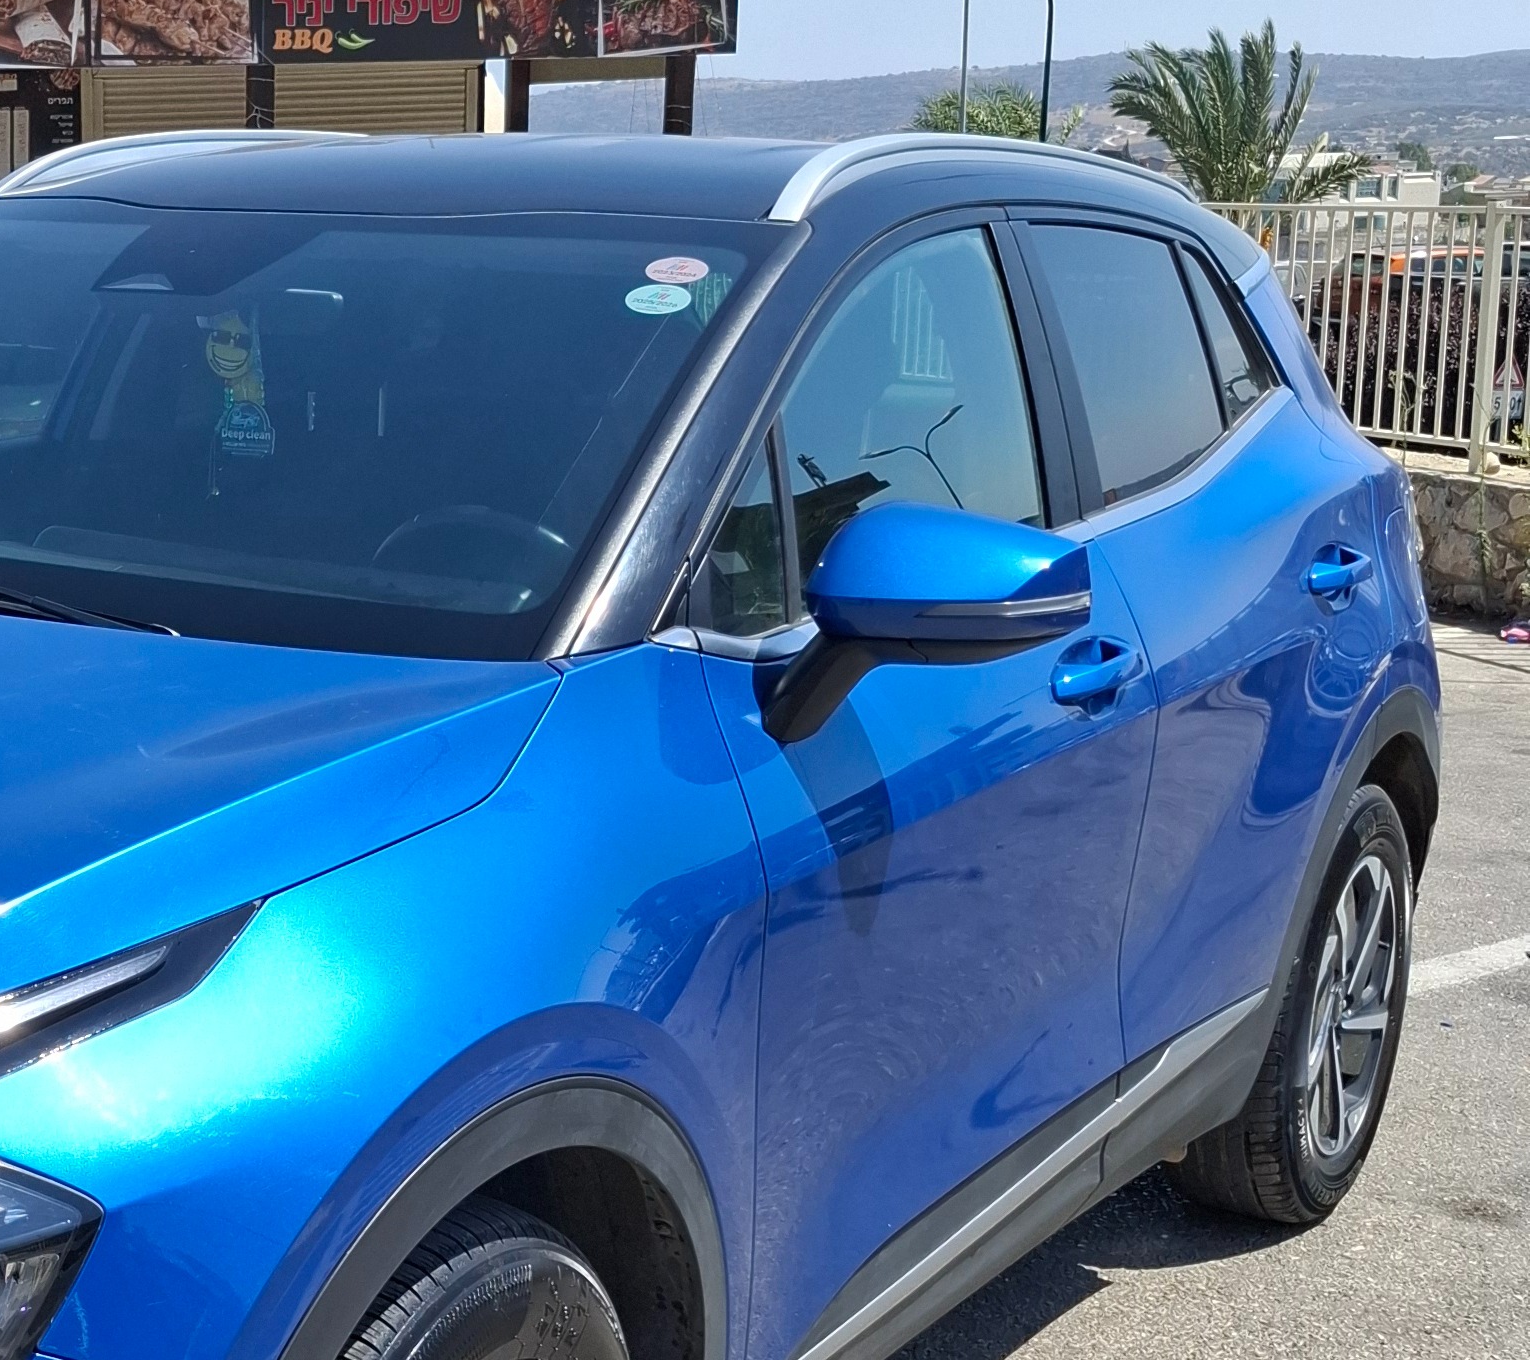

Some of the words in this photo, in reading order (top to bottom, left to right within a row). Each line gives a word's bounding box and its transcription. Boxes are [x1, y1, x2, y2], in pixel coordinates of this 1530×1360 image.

[273, 28, 333, 54] BBQ
[221, 427, 245, 440] Deep
[246, 429, 271, 440] clean
